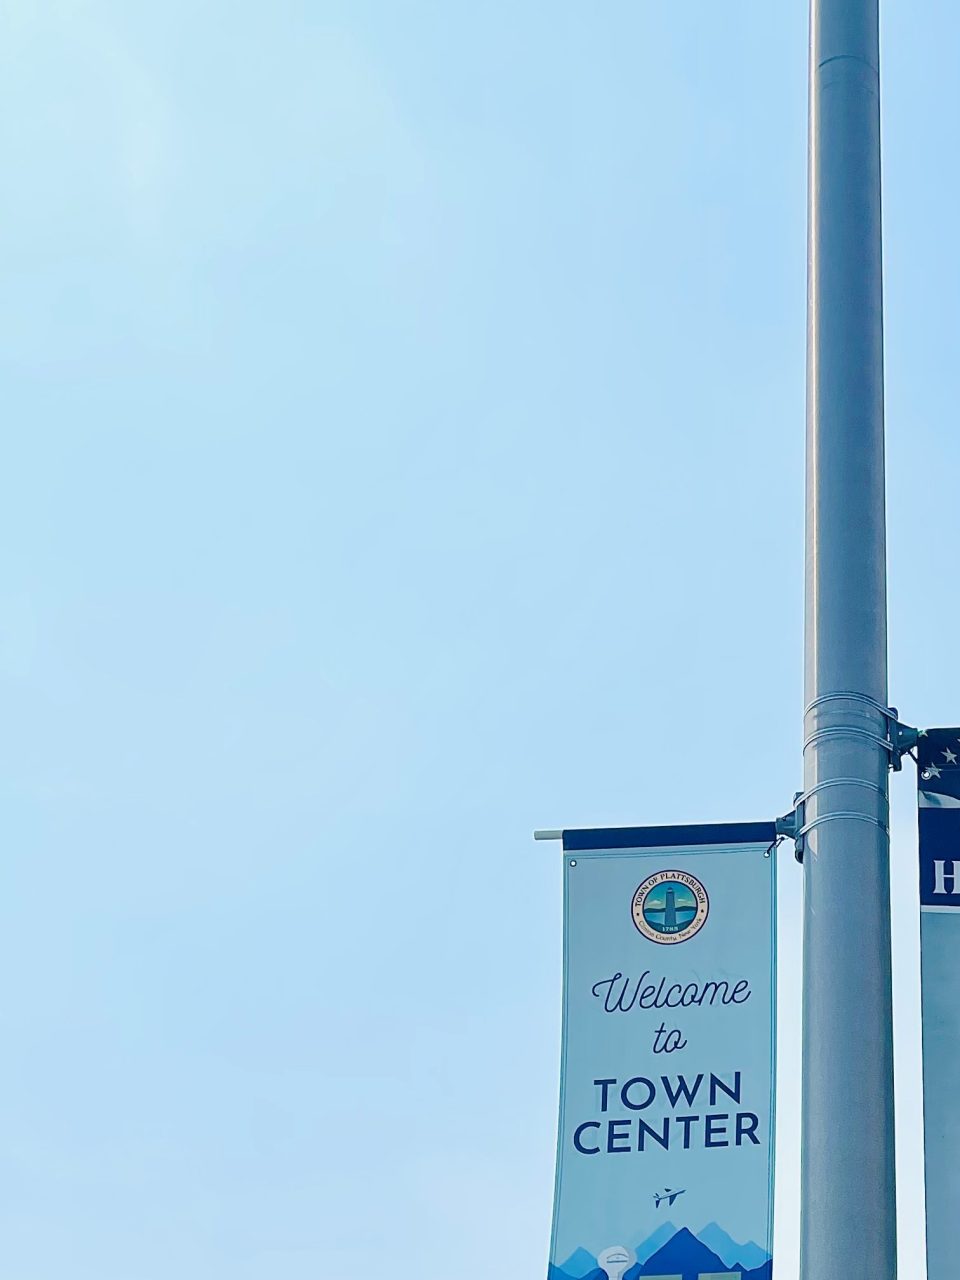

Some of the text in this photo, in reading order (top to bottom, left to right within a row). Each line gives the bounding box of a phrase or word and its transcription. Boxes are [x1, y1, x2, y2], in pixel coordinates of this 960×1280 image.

[635, 873, 706, 907] TOWN OF PLATTSBURGH
[592, 970, 751, 1013] Welcome
[653, 1022, 688, 1054] to
[593, 1071, 741, 1112] TOWN
[573, 1112, 761, 1155] CENTER
